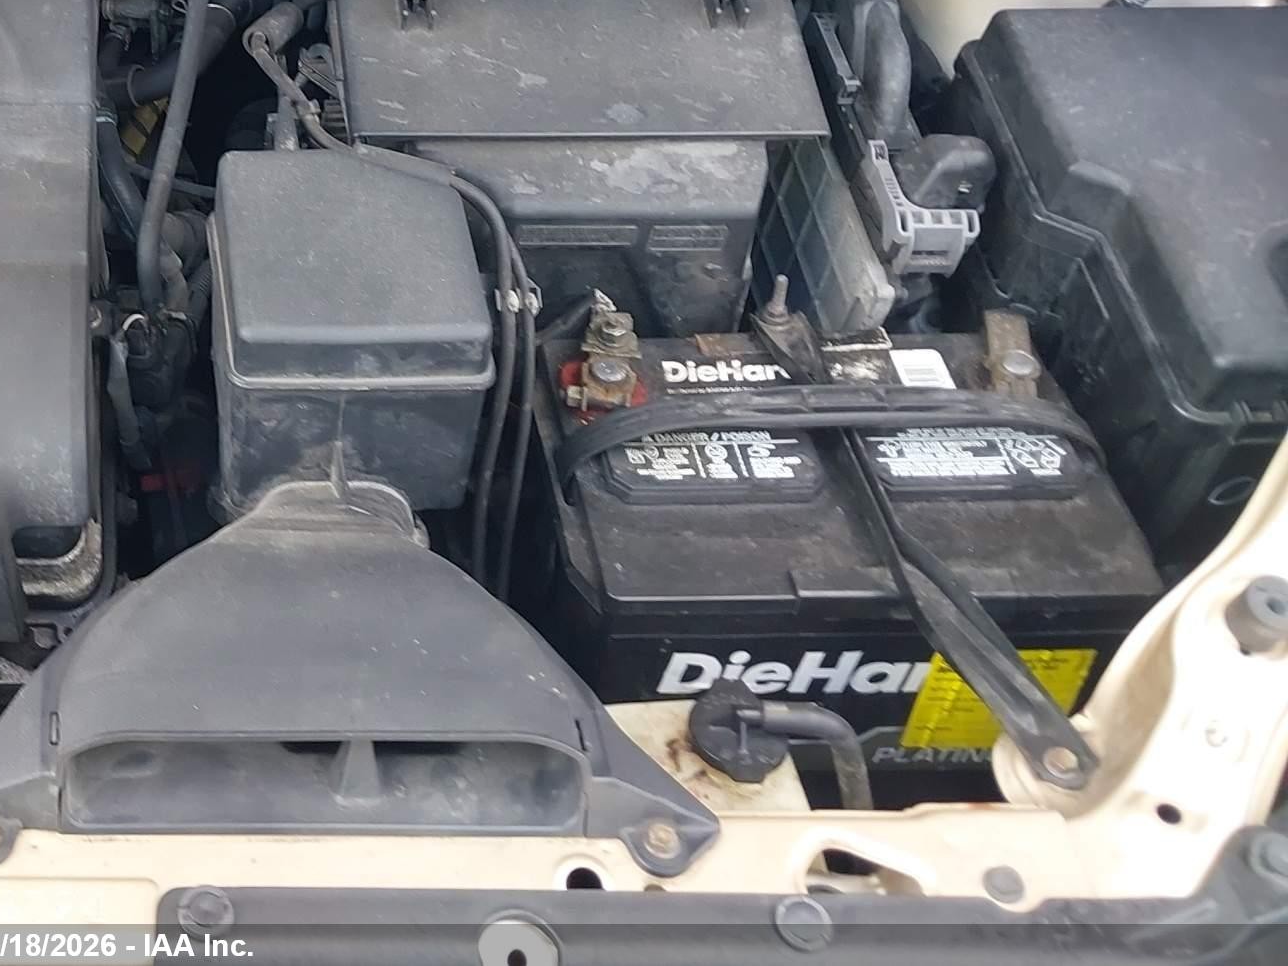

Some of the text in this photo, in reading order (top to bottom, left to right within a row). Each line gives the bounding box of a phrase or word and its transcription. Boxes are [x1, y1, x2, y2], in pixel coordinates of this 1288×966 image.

[661, 359, 792, 383] DieHar
[656, 649, 930, 695] DieHar
[871, 746, 993, 763] PLATIN
